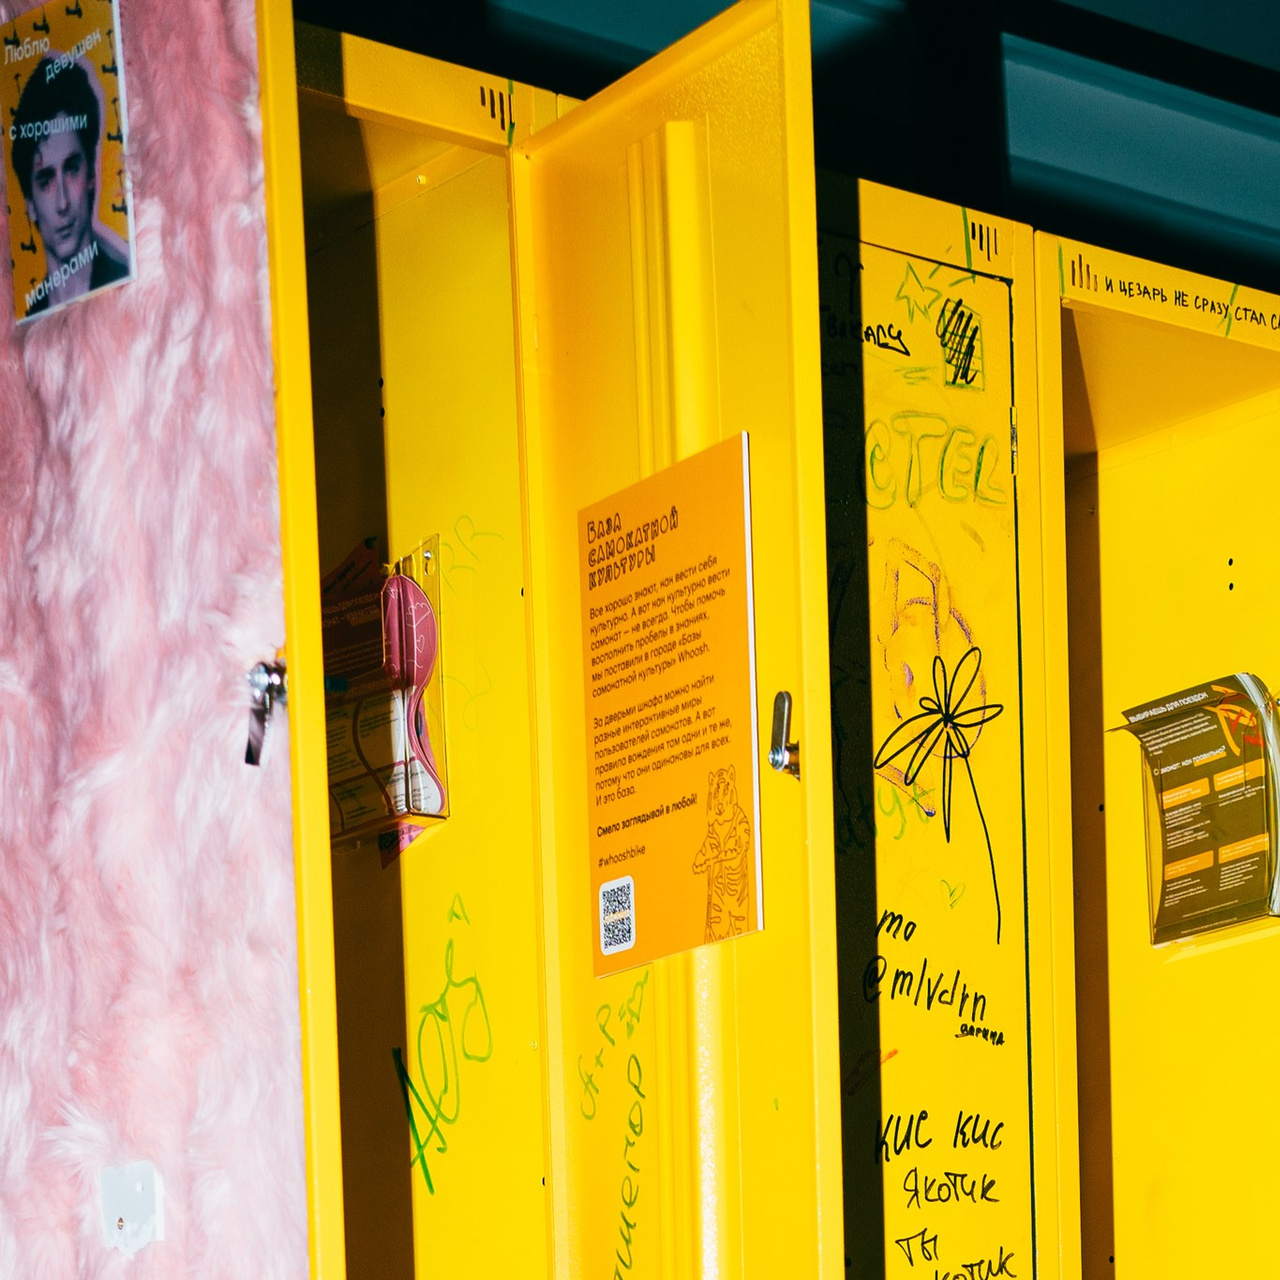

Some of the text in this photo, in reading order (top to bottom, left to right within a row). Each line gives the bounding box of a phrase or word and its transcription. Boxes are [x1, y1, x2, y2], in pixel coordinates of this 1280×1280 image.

[4, 36, 50, 65] Люблю
[44, 28, 102, 83] девушек
[9, 112, 88, 141] с хорошими
[25, 239, 99, 309] манерами
[1105, 276, 1113, 293] И
[1119, 279, 1168, 304] ЦЕЗАРЬ
[1174, 290, 1189, 308] НЕ
[1195, 296, 1231, 320] СРАЗУ
[1234, 306, 1267, 328] СТАЛ
[596, 821, 620, 838] Смело
[620, 803, 664, 830] заглядывай
[664, 804, 670, 814] в
[597, 844, 646, 868] #whooshbike
